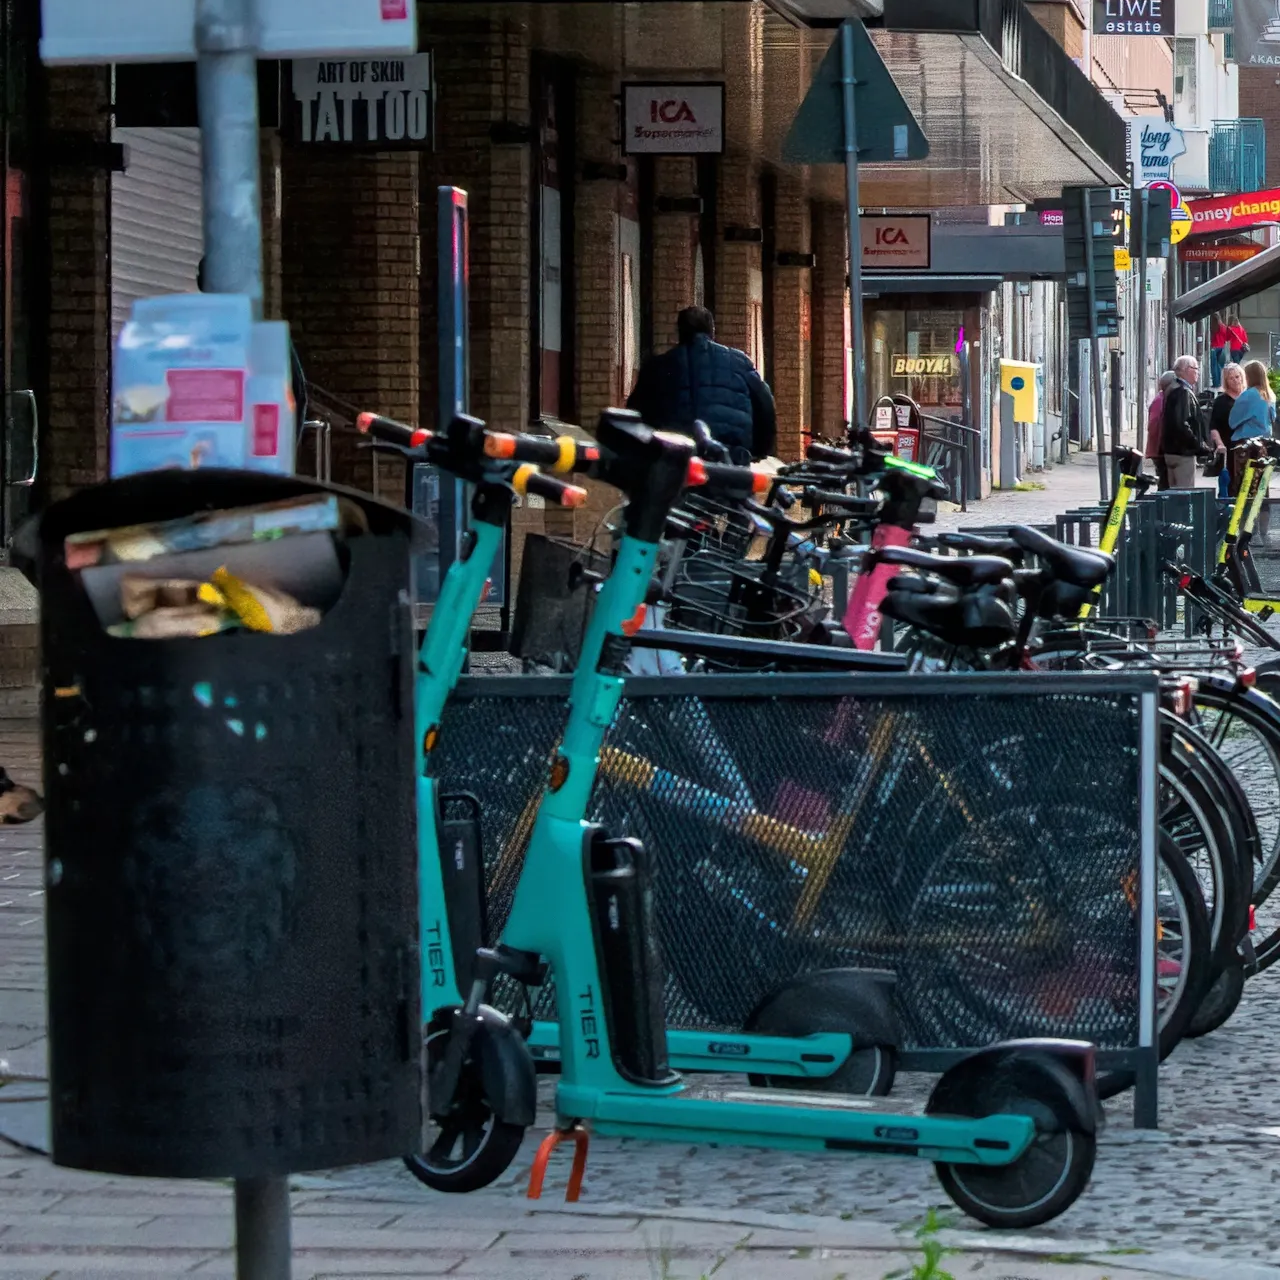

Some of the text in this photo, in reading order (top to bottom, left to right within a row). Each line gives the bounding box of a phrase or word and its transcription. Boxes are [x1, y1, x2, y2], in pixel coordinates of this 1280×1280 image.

[1105, 0, 1162, 17] LIWE
[1105, 20, 1162, 33] estate
[317, 60, 405, 84] ART OF SKIN
[294, 88, 428, 142] TATTOO
[650, 100, 697, 123] ICA
[875, 227, 909, 245] ICA
[894, 358, 950, 374] BOOYA!
[426, 920, 446, 988] TIER
[578, 984, 600, 1060] TIER
